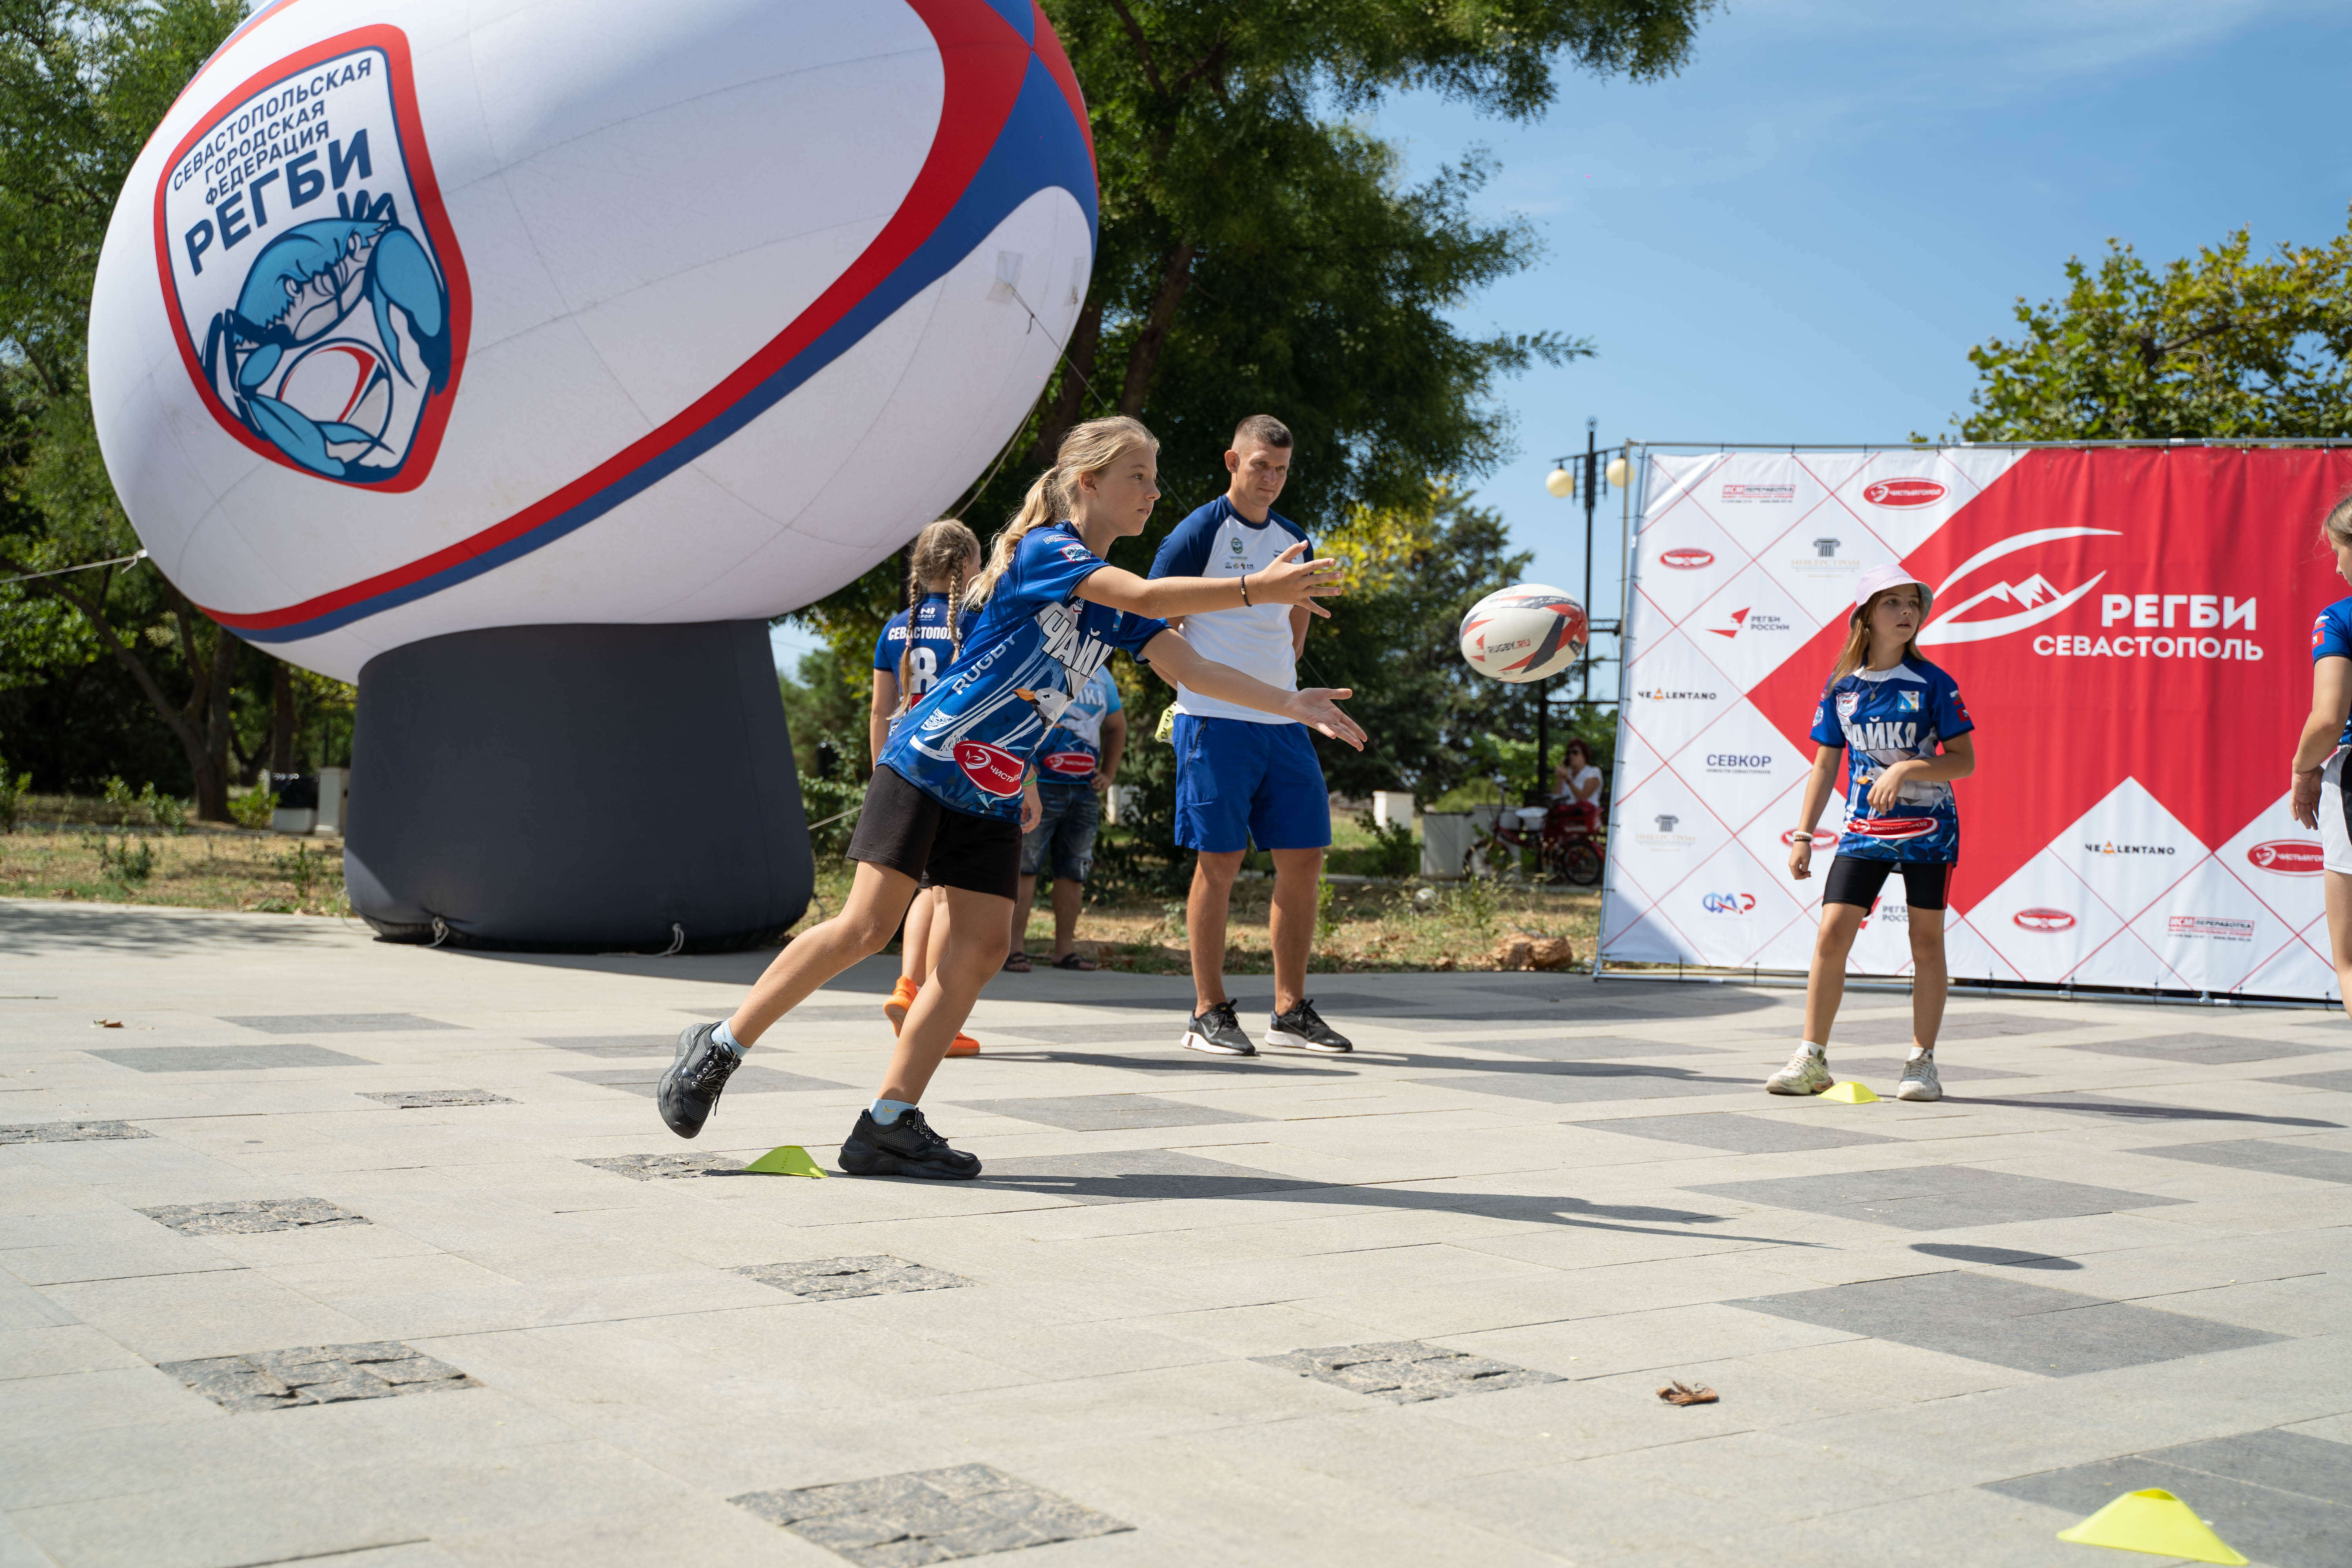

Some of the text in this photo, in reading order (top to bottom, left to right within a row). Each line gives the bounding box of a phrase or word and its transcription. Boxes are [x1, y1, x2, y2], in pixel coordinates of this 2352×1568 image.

[174, 58, 371, 191] СЕВАСТОПОЛЬСКАЯ
[205, 100, 325, 184] ГОРОДСКАЯ
[206, 121, 329, 205] ФЕДЕРАЦИЯ
[185, 128, 372, 276] РЕГБИ
[2101, 594, 2256, 630] РЕГБИ
[910, 647, 938, 694] 8
[952, 635, 1015, 695] RUGBY
[2033, 635, 2263, 661] СЕВАСТОПОЛЬ
[1707, 755, 1771, 767] СЕВКОР
[781, 1151, 790, 1169] KIPSTA
